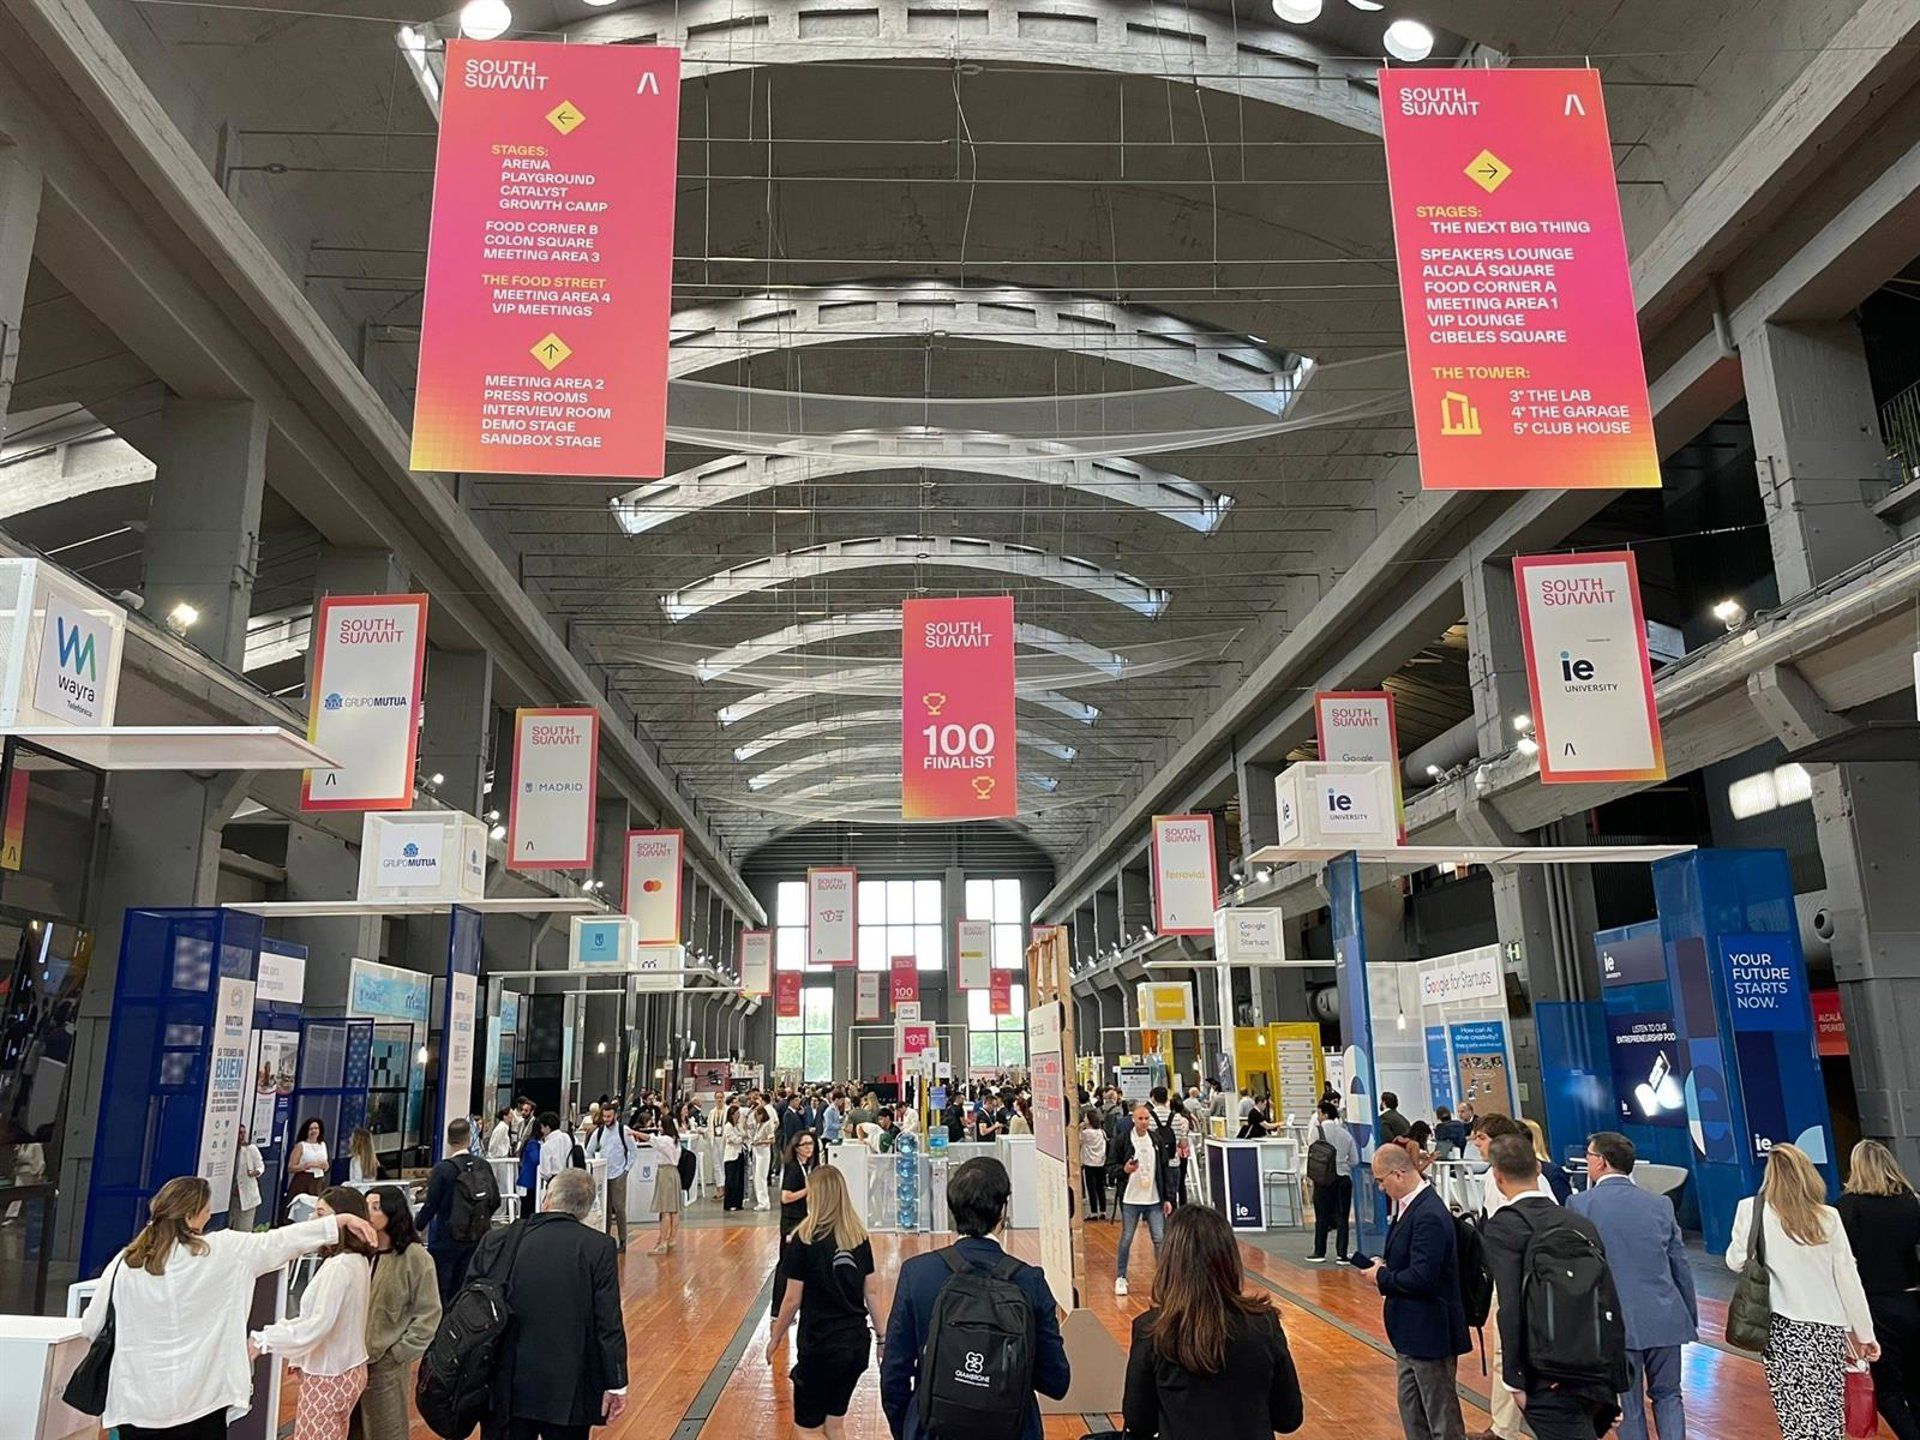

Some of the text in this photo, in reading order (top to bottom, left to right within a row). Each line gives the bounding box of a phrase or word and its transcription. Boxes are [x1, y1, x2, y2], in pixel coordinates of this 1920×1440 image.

[465, 59, 536, 74] SOUTH
[464, 74, 549, 90] SUMMIT
[1400, 88, 1466, 101] SOUTH
[1401, 101, 1480, 116] SUMMIT
[491, 145, 548, 157] STAGES:
[502, 159, 551, 170] ARENA
[501, 173, 595, 185] PLAYGROUND
[500, 186, 567, 198] CATALYST
[499, 200, 608, 212] GROWTH CAMP
[1416, 206, 1482, 217] STAGES:
[485, 221, 599, 235] FOOD CORNER B
[1430, 221, 1590, 233] THE NEXT BIG THING
[485, 235, 594, 249] COLON SQUARE
[484, 248, 600, 263] MEETING AREA 3
[1421, 248, 1573, 260] SPEAKERS LOUNGE
[1423, 263, 1555, 277] ALCALÁ SQUARE
[482, 274, 607, 289] THE FOOD STREET
[1424, 281, 1557, 293] FOOD CORNER A
[493, 289, 611, 303] MEETING AREA 4
[493, 303, 593, 317] VIP MEETINGS
[1426, 298, 1559, 310] MEETING AREA 1
[1428, 314, 1525, 326] VIP LOUNGE
[1430, 331, 1566, 343] CIBELES SQUARE
[1432, 367, 1530, 379] THE TOWER:
[485, 375, 605, 389] MEETING AREA 2
[484, 390, 588, 403] PRESS ROOMS
[1527, 390, 1558, 402] THE
[1561, 390, 1591, 402] LAB
[483, 404, 611, 419] INTERVIEW ROOM
[1529, 406, 1560, 418] THE
[1563, 406, 1630, 418] GARAGE
[482, 419, 576, 432] DEMO STAGE
[1532, 422, 1572, 434] CLUB
[1577, 422, 1631, 434] HOUSE
[481, 433, 602, 448] SANDBOX STAGE
[1541, 578, 1603, 593] SOUTH
[1543, 590, 1616, 606] SUMMIT
[341, 619, 395, 631] SOUTH
[925, 622, 981, 635] SOUTH
[340, 630, 404, 644] SUMMIT
[925, 634, 992, 648] SUMMIT
[1561, 651, 1594, 681] ie
[58, 674, 95, 702] wayra
[1565, 683, 1618, 693] UNIVERSITY
[1332, 708, 1372, 718] SOUTH
[1333, 717, 1379, 727] SUMMIT
[532, 726, 574, 736] SOUTH
[532, 735, 582, 745] SUMMIT
[922, 723, 995, 756] 100
[923, 756, 994, 769] FINALIST
[539, 782, 583, 792] MADRID
[1328, 788, 1352, 811] ie
[1330, 813, 1368, 821] UNIVERSITY
[1165, 827, 1196, 836] SOUTH
[1165, 835, 1201, 843] SUMMIT
[637, 842, 667, 850] SOUTH
[637, 849, 671, 857] SUMMIT
[1166, 868, 1205, 879] ferrovial
[1729, 954, 1771, 965] YOUR
[1733, 968, 1790, 980] FUTURE
[1424, 976, 1450, 997] Google
[1461, 970, 1492, 989] Startups
[1735, 983, 1788, 994] STARTS
[895, 987, 913, 997] 100
[1737, 997, 1779, 1009] NOW.
[215, 1058, 244, 1078] BUEN
[1755, 1133, 1772, 1151] ie
